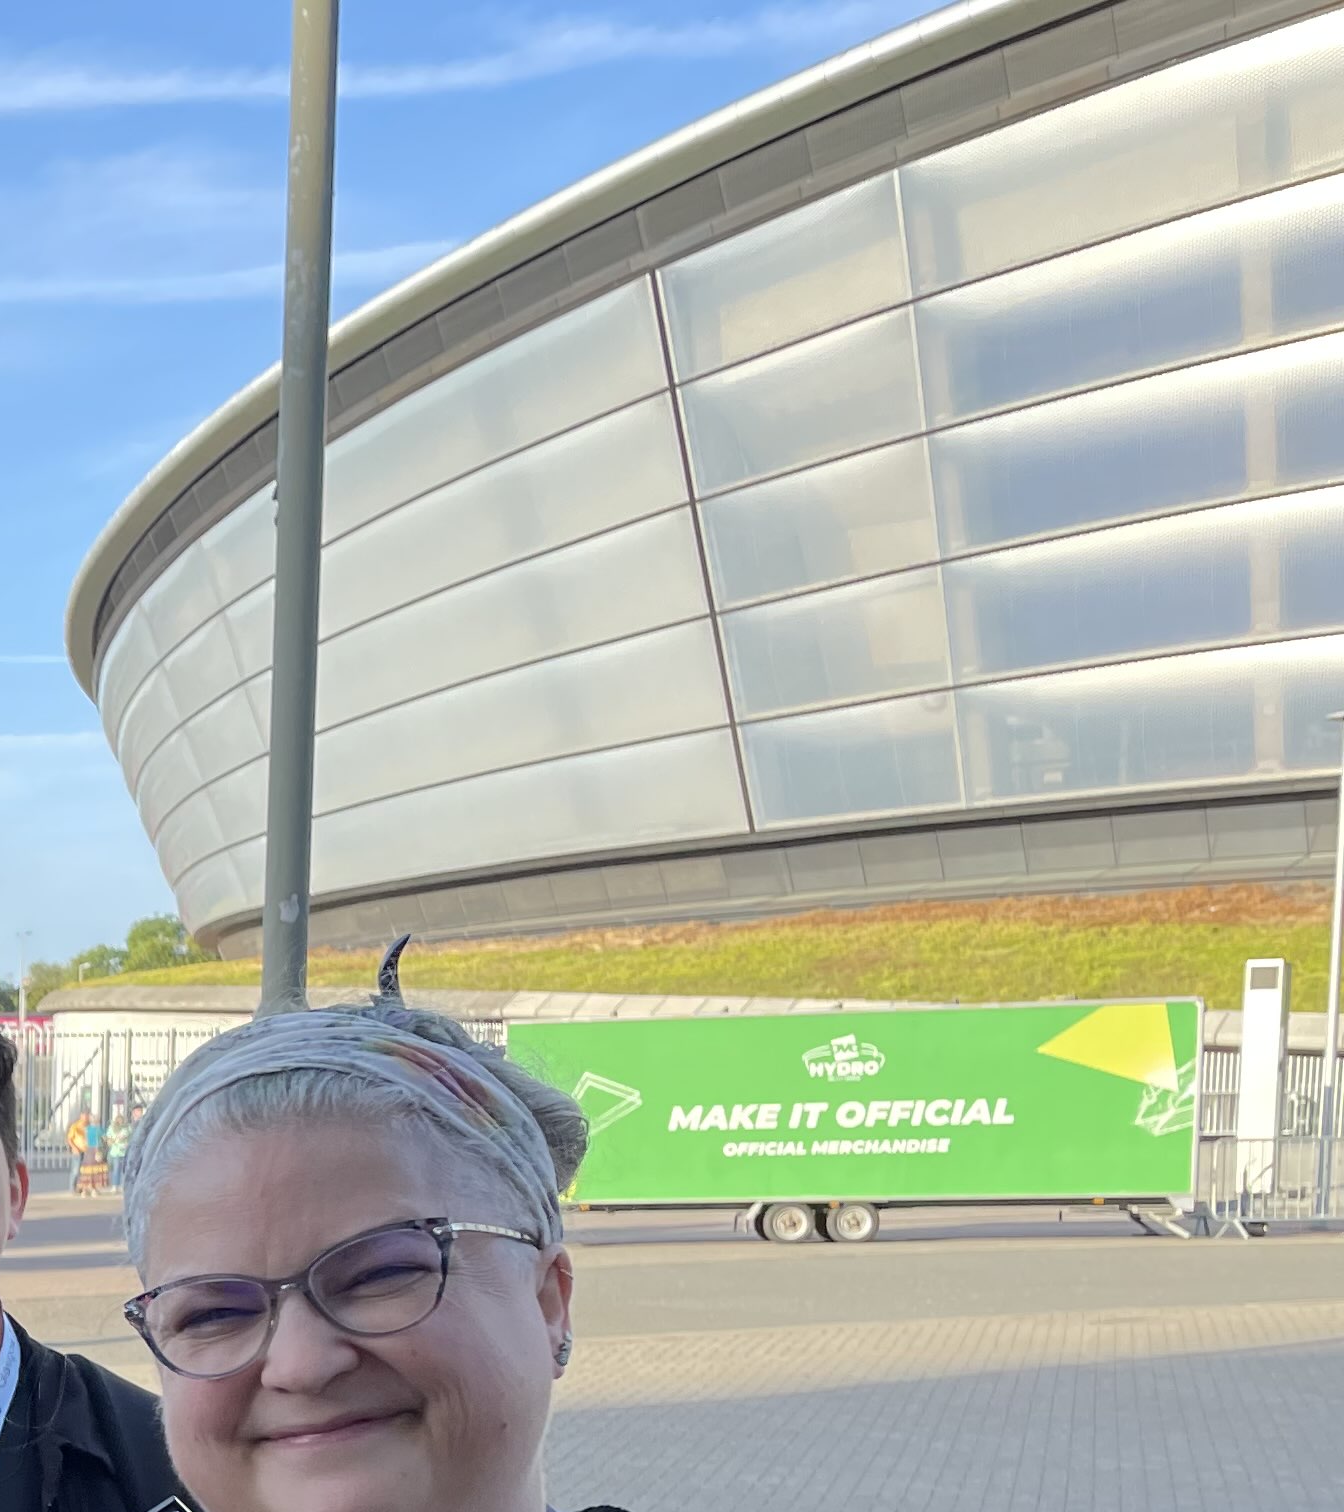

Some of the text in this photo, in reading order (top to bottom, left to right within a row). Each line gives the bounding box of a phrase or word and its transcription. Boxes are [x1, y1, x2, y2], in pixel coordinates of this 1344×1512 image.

[809, 1060, 880, 1078] HYDRO
[668, 1098, 1015, 1132] MAKE IT OFFICIAL
[723, 1138, 951, 1157] OFFICIAL MERCHANDISE
